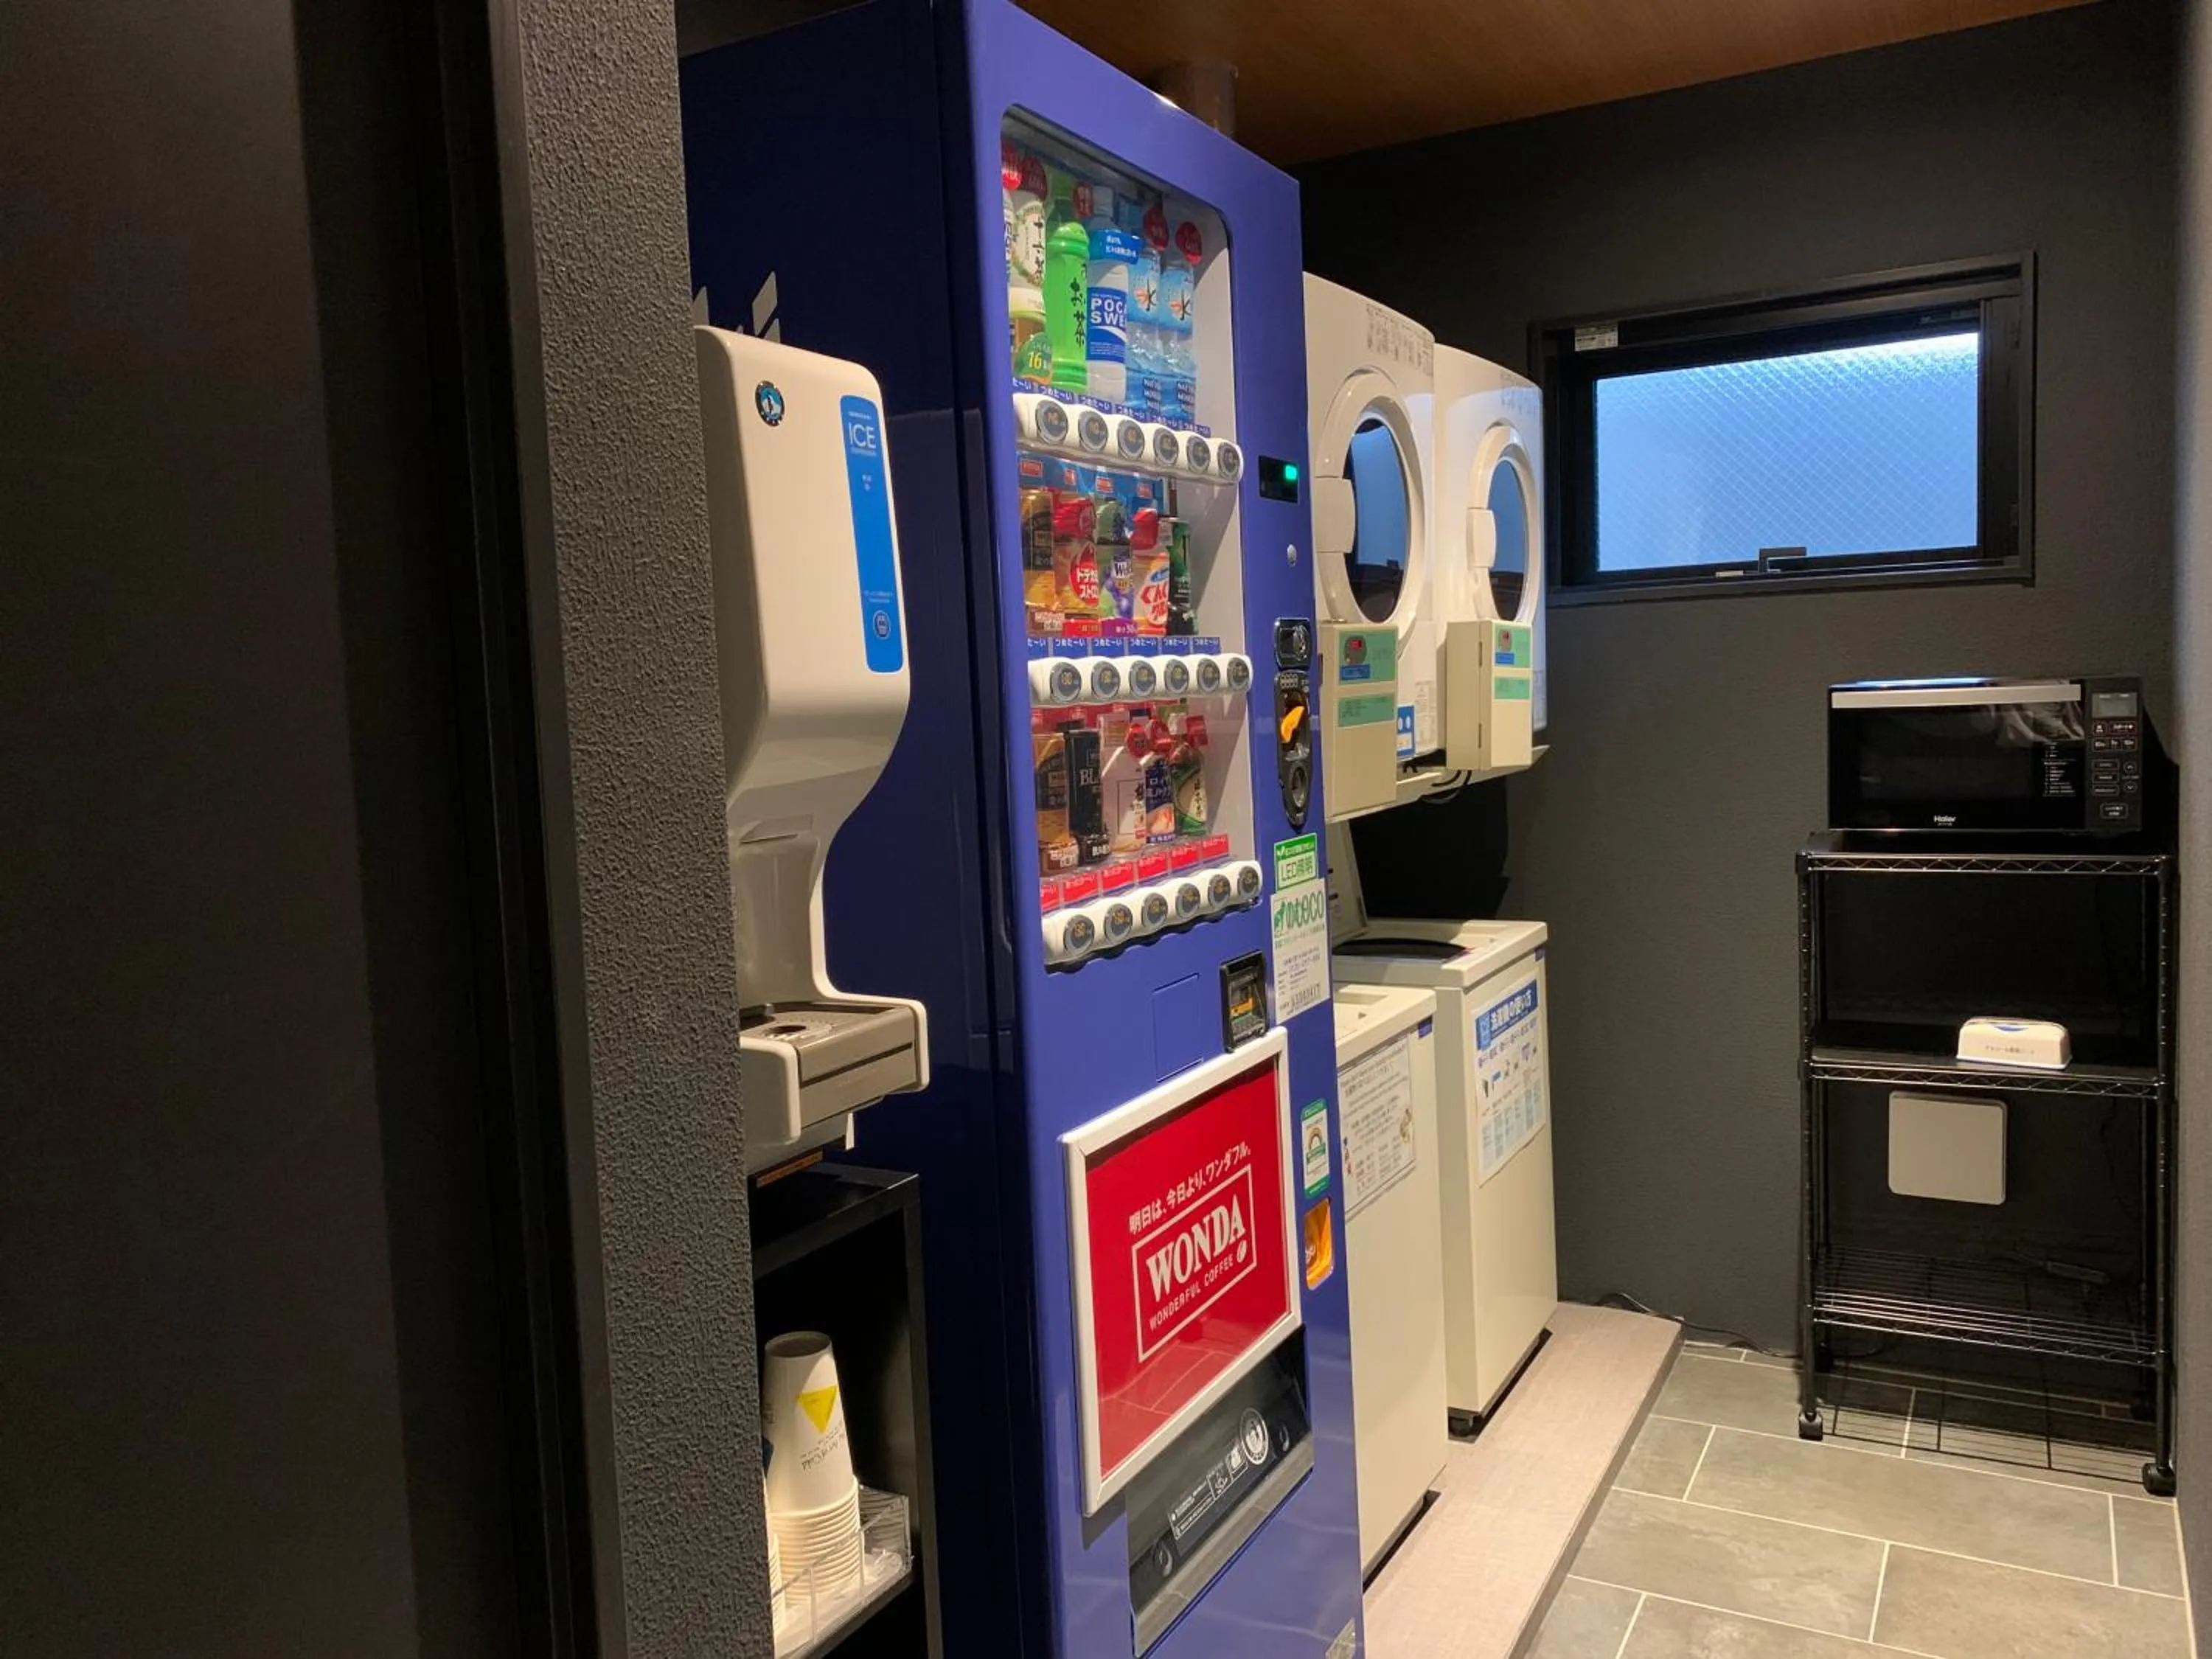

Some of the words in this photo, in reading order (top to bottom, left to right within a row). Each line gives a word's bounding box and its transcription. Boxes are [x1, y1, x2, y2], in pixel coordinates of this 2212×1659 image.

[849, 422, 876, 448] ICE
[1129, 1141, 1251, 1235] 明日は、今日より、ワンダフル。
[1146, 1194, 1247, 1303] WONDA
[1150, 1281, 1201, 1331] WONDERFUL
[1204, 1253, 1234, 1287] COFFEE
